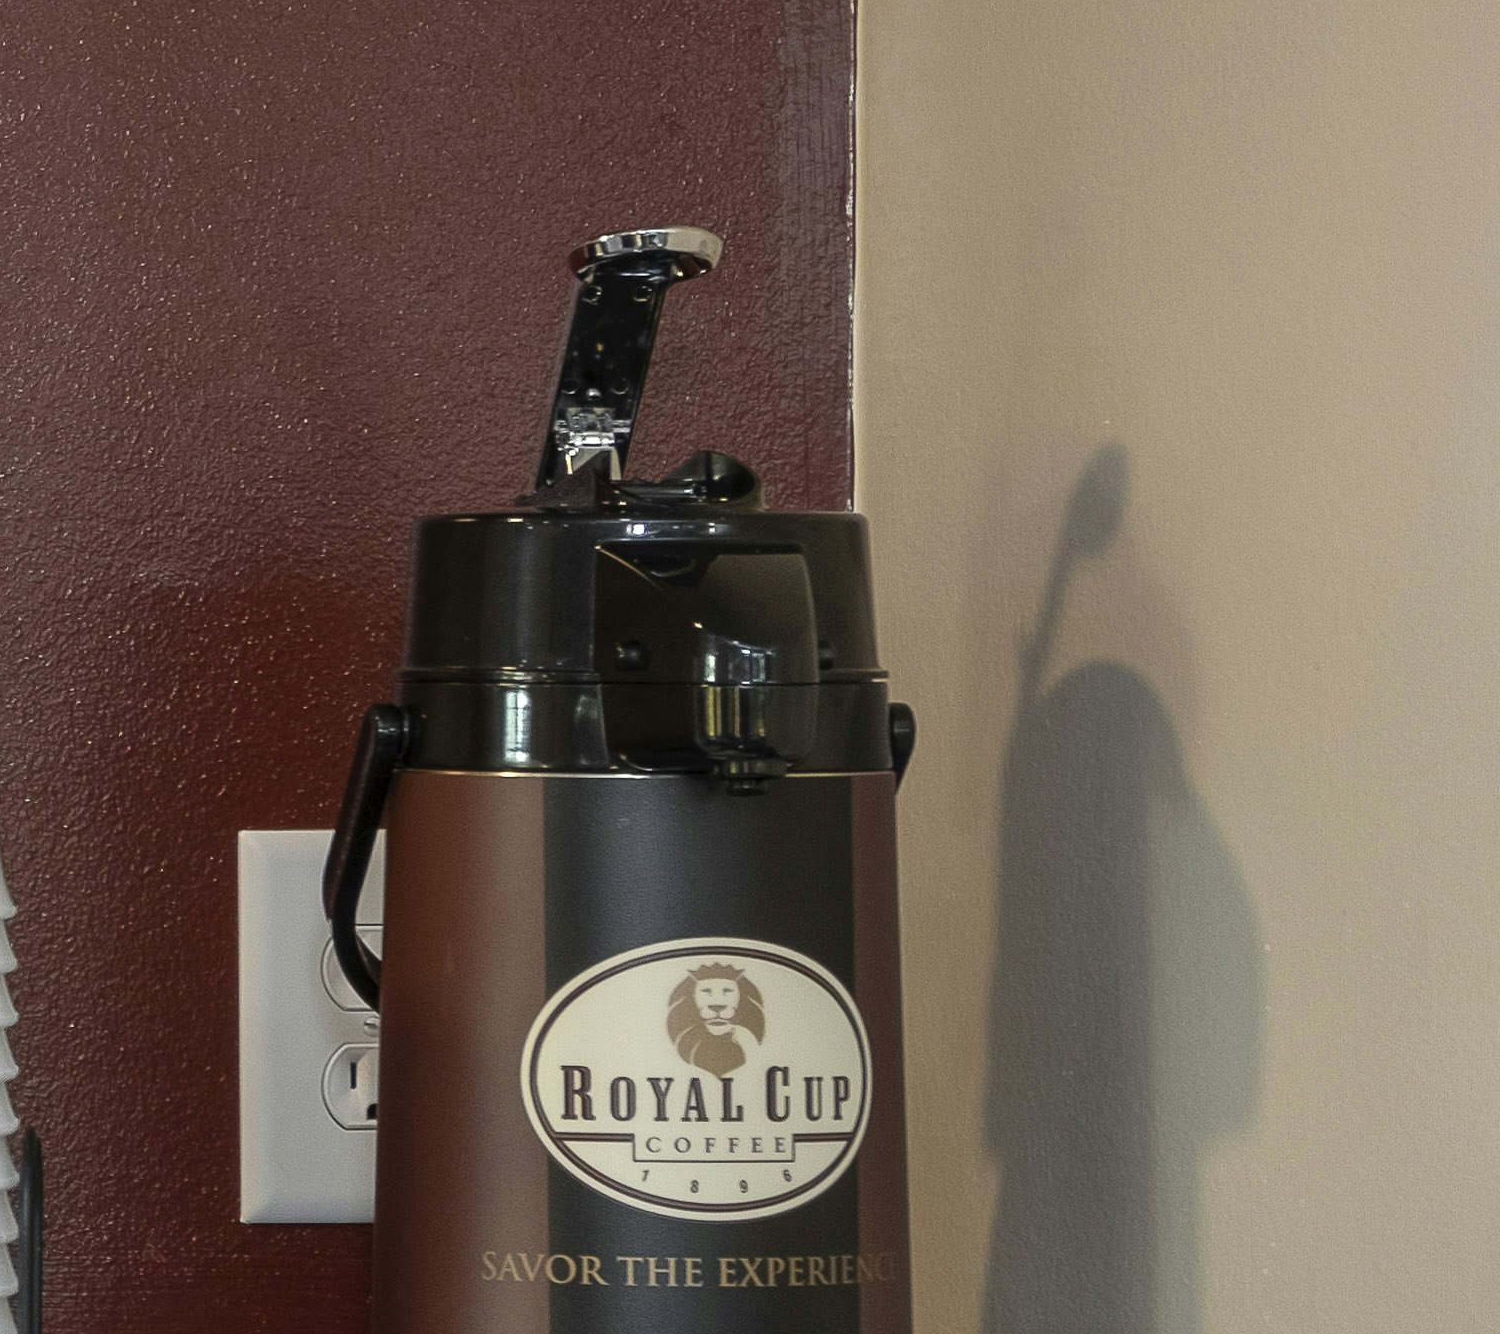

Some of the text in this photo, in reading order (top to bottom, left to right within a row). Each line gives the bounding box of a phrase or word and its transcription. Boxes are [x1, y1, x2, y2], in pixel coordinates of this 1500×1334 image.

[561, 1065, 851, 1123] ROYAL CUP
[645, 1136, 787, 1154] COFFEE
[482, 1250, 608, 1287] SAVOR
[616, 1255, 704, 1288] THE
